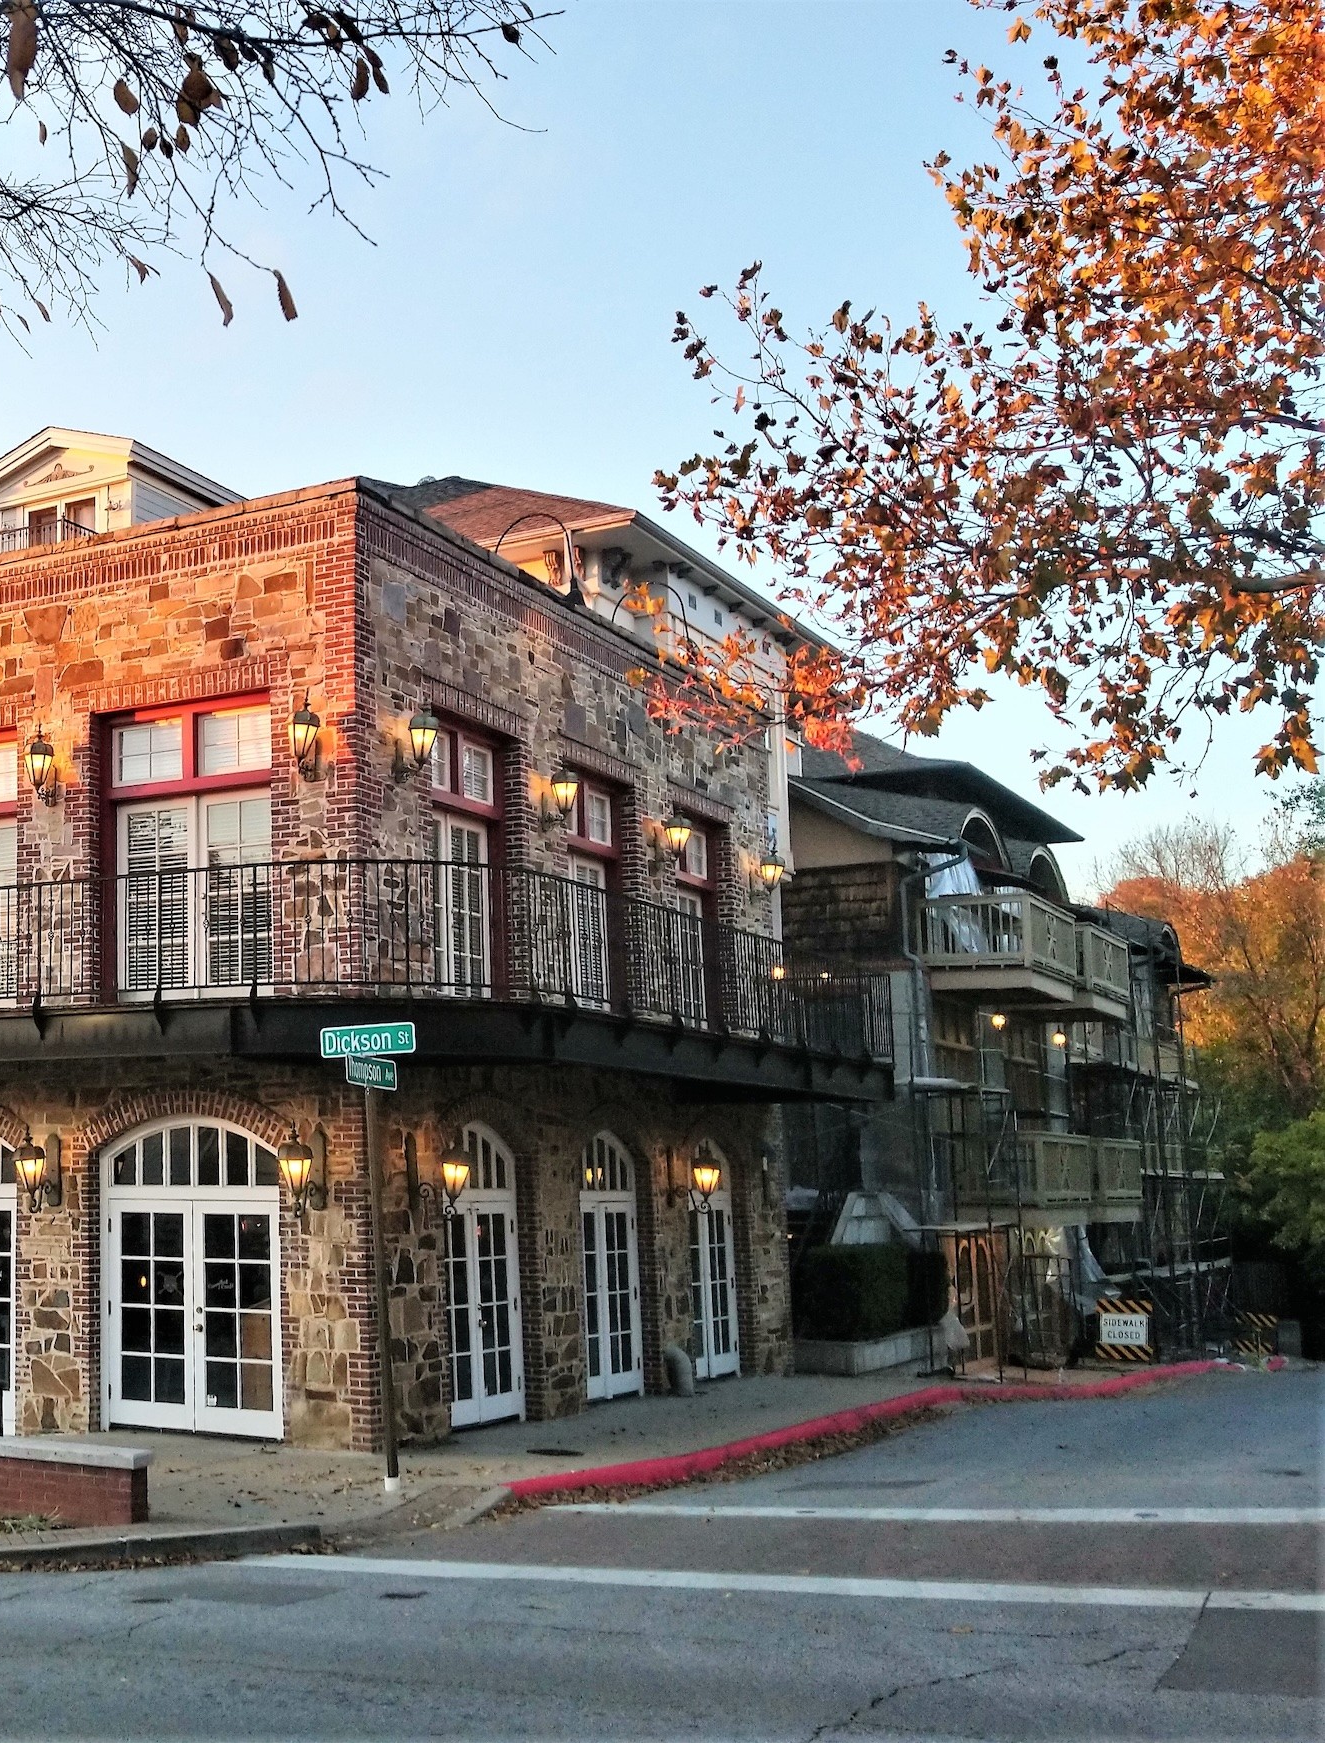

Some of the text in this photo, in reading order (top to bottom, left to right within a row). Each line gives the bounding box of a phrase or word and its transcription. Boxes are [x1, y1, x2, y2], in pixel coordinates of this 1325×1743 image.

[325, 1030, 409, 1054] Dickson St
[348, 1055, 394, 1082] Thompson Ave
[1103, 1318, 1145, 1327] SIDEWALK
[1108, 1330, 1140, 1339] CLOSED
